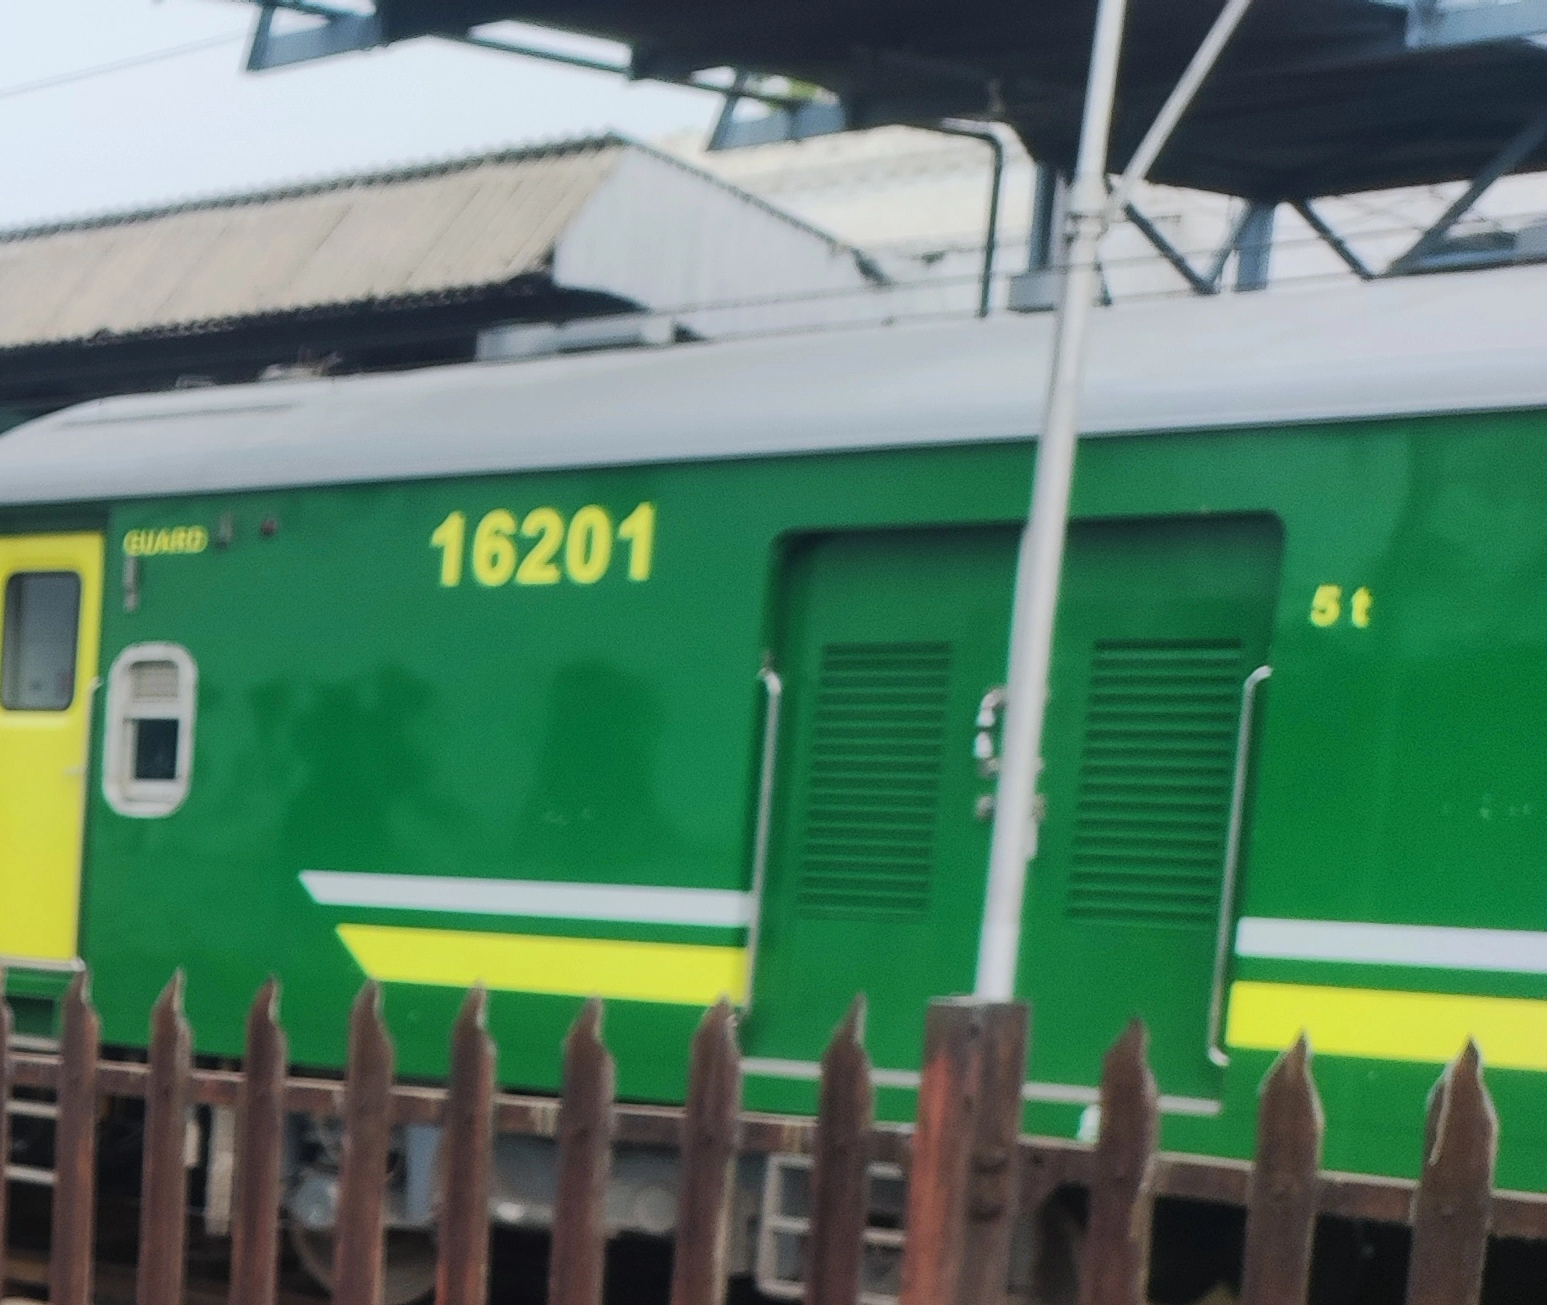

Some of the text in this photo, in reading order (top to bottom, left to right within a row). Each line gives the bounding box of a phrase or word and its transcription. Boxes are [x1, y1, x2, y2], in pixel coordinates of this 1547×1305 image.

[123, 525, 207, 556] GUARD
[430, 501, 655, 587] 16201
[1311, 585, 1341, 627] 5
